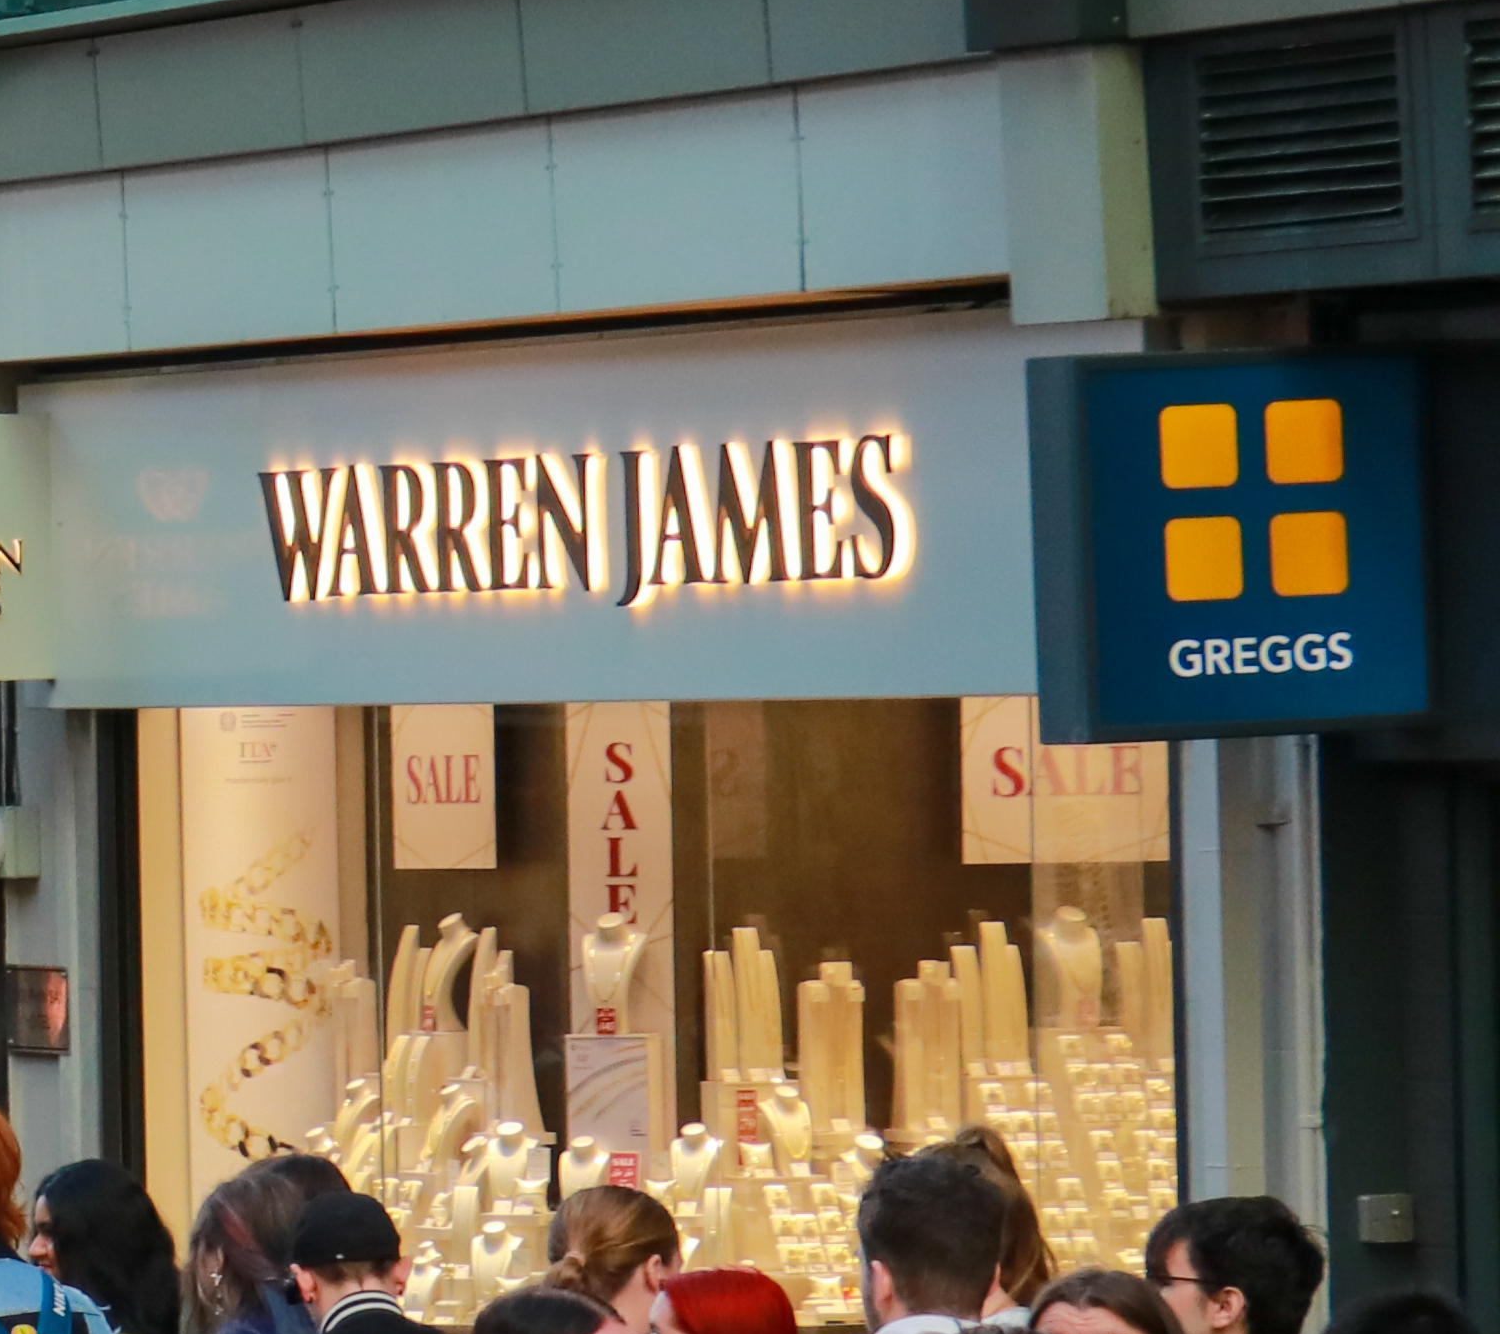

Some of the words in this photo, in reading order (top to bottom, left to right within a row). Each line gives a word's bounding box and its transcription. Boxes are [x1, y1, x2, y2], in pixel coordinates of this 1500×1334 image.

[258, 450, 609, 603] WARREN
[615, 433, 906, 607] JAMES
[1169, 632, 1354, 678] GREGGS
[406, 753, 481, 805] SALE
[992, 746, 1144, 798] SALE
[601, 741, 639, 925] SALE
